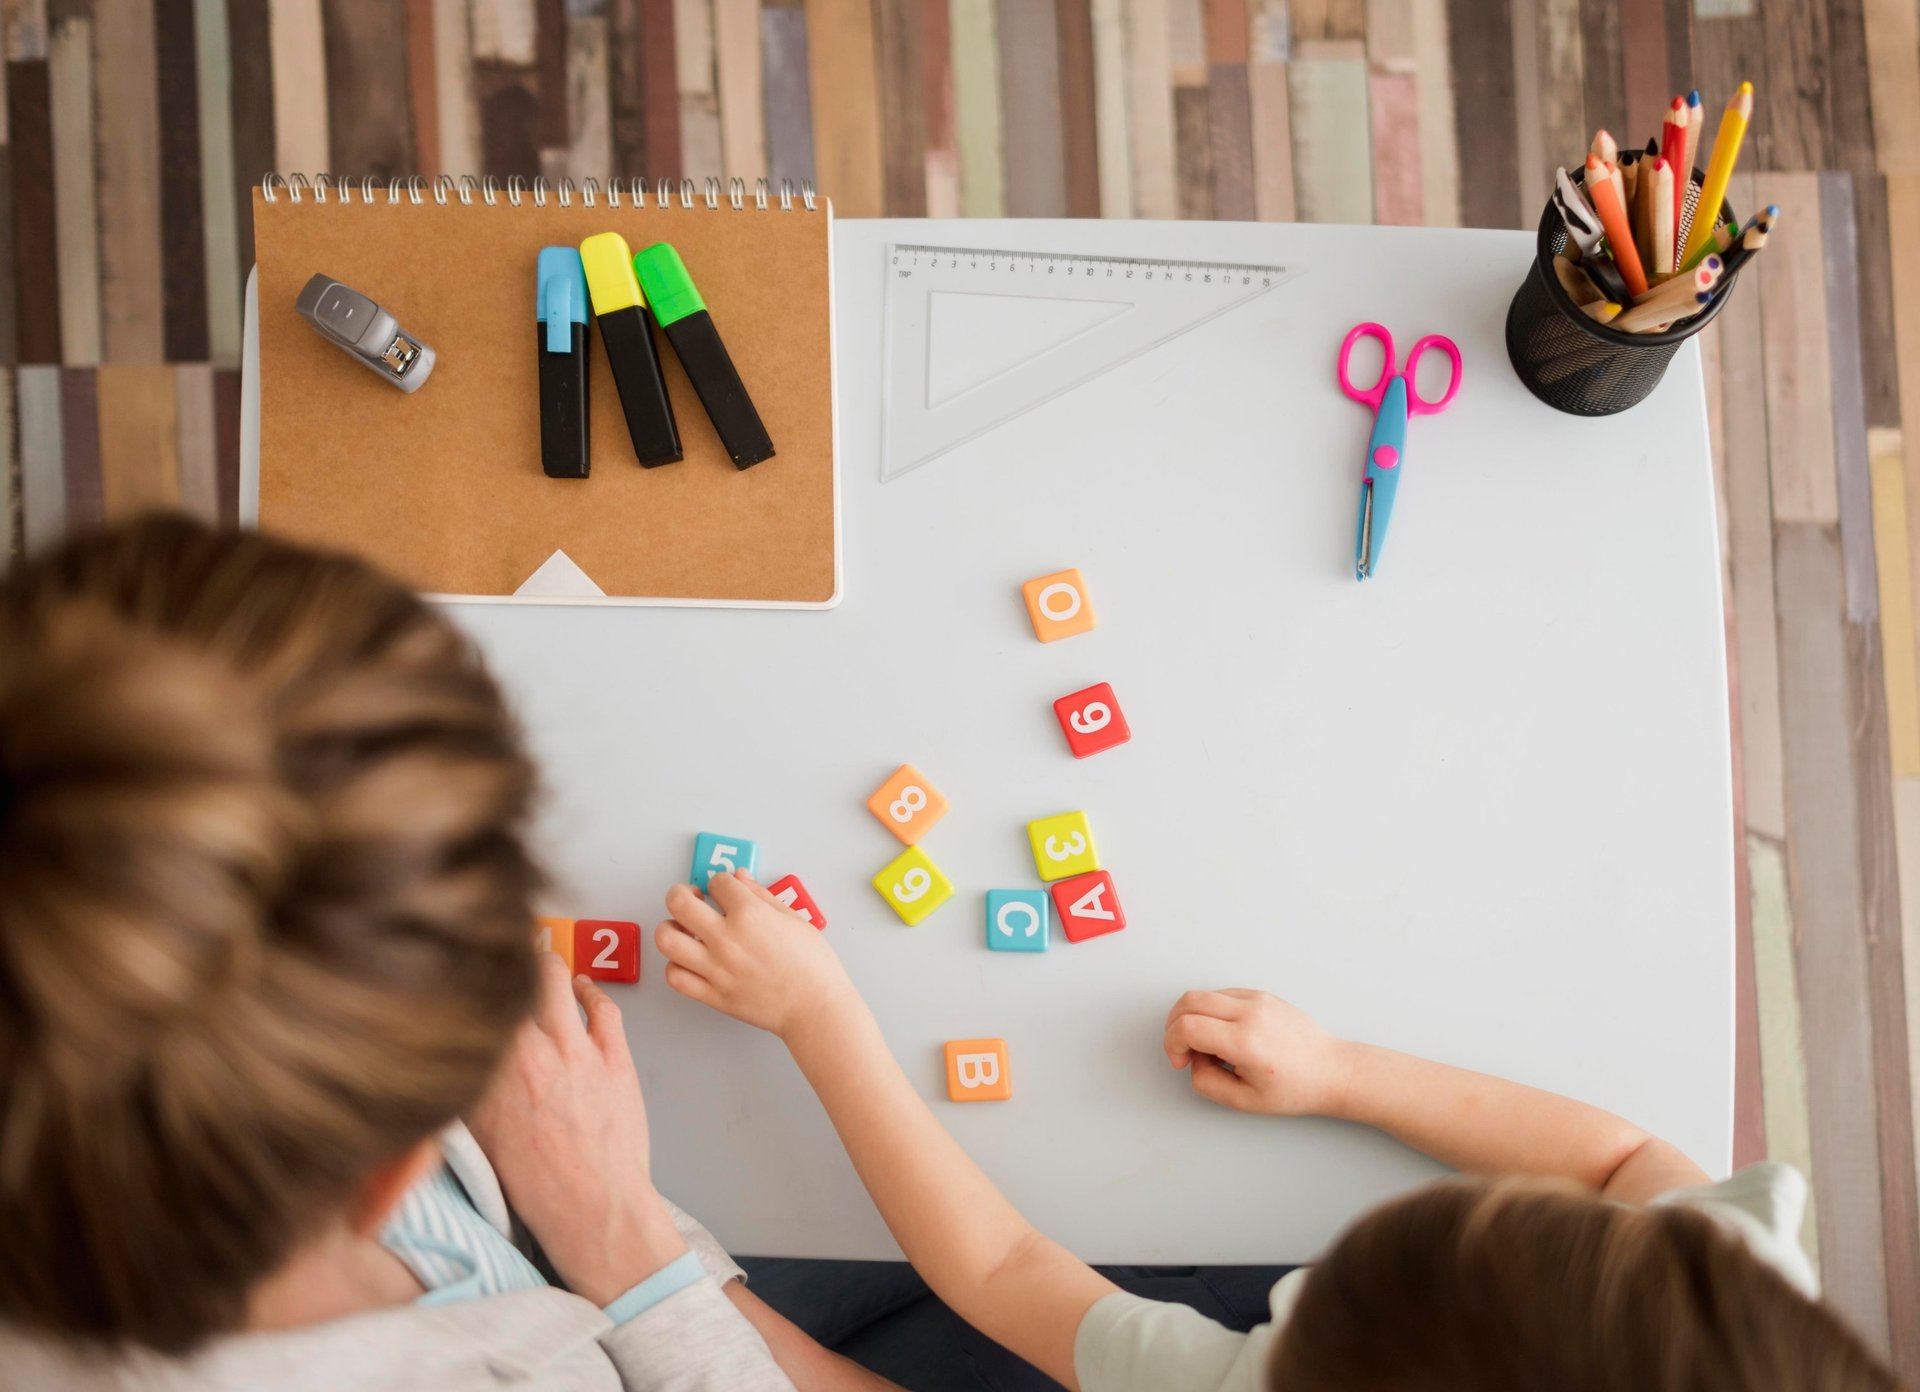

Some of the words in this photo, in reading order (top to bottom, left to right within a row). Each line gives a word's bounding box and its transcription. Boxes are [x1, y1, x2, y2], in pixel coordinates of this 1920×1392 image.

[1086, 268, 1094, 276] 10
[1106, 269, 1113, 277] 11
[1126, 270, 1133, 278] 12
[1145, 271, 1152, 280] 13
[1164, 272, 1172, 280] 14
[1184, 273, 1192, 281] 15
[1223, 275, 1231, 284] 17
[888, 785, 928, 823] 8
[707, 843, 738, 880] 5
[1045, 830, 1086, 862] 3
[996, 901, 1040, 938] C
[1069, 881, 1116, 921] A
[591, 928, 620, 969] 2
[956, 1052, 1000, 1089] B
